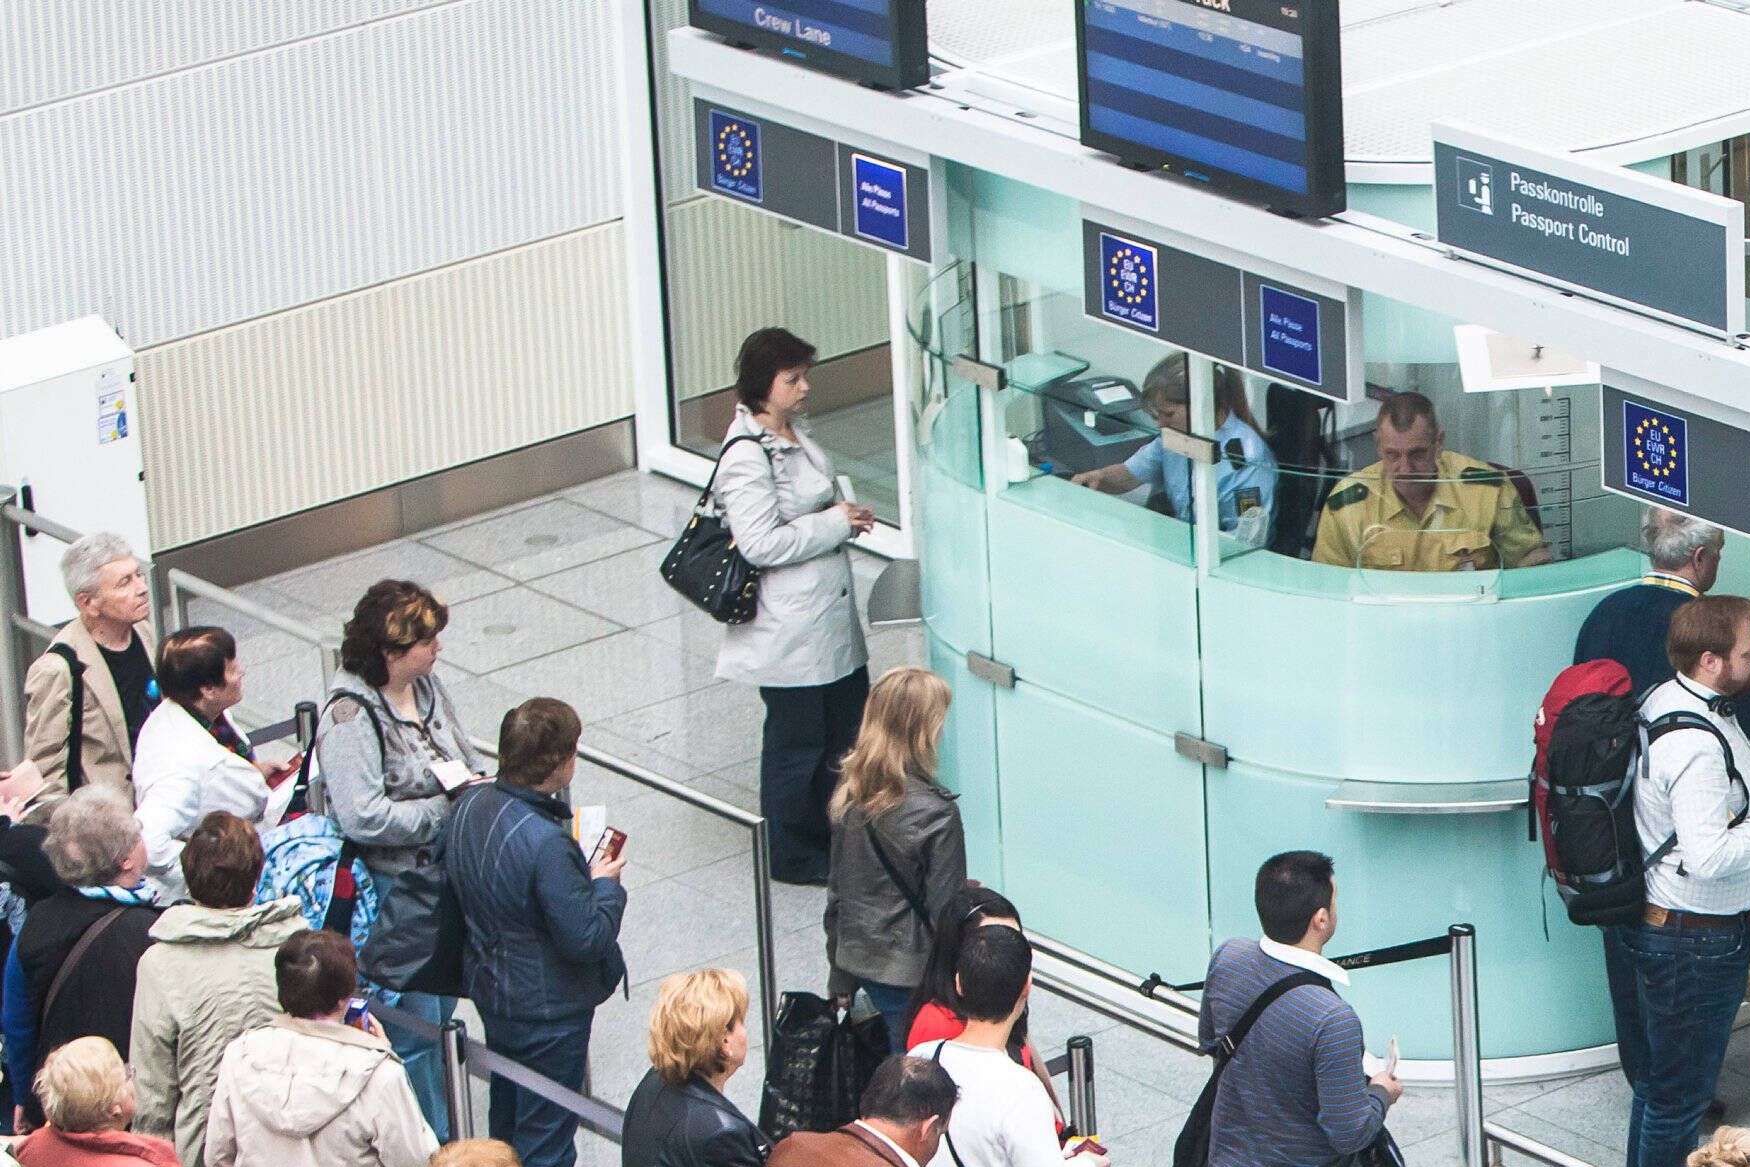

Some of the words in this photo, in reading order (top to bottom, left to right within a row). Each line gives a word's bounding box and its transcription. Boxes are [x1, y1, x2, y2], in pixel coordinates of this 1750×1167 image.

[754, 7, 793, 34] Crew
[795, 19, 831, 46] Lane
[1510, 171, 1604, 218] Passkontrolle
[1511, 203, 1574, 241] Passport
[1578, 223, 1630, 257] Control
[1646, 440, 1665, 455] EWR
[1650, 429, 1661, 442] EU
[1650, 453, 1662, 465] CH
[1632, 471, 1655, 489] Bürger
[1658, 481, 1681, 497] Citizen
